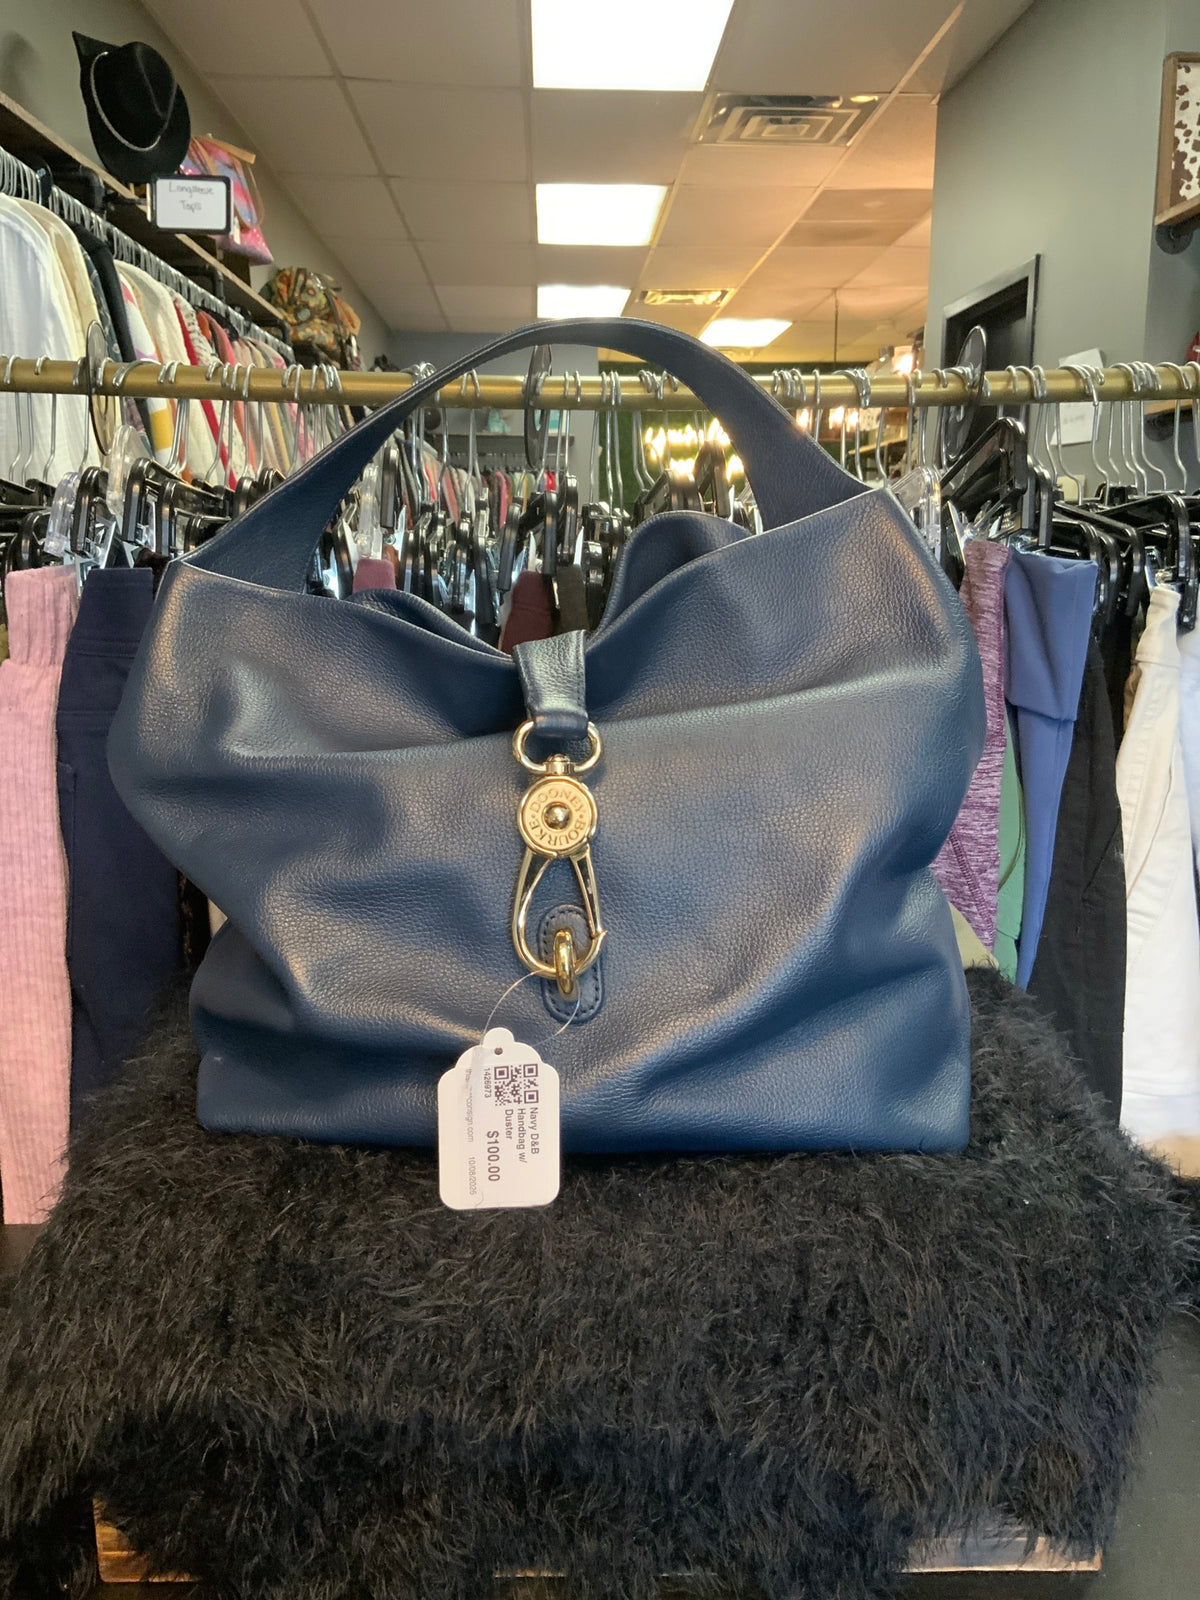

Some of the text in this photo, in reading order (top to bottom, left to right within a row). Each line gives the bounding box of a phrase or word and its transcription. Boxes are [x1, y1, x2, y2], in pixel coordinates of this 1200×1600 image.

[529, 788, 587, 813] DOONEY
[529, 819, 587, 846] BOURKE
[484, 1067, 492, 1098] 1426973
[505, 1108, 514, 1140] Duster
[516, 1108, 528, 1163] Handbag w/
[528, 1107, 540, 1155] Navy D&B
[486, 1130, 501, 1182] $100.00
